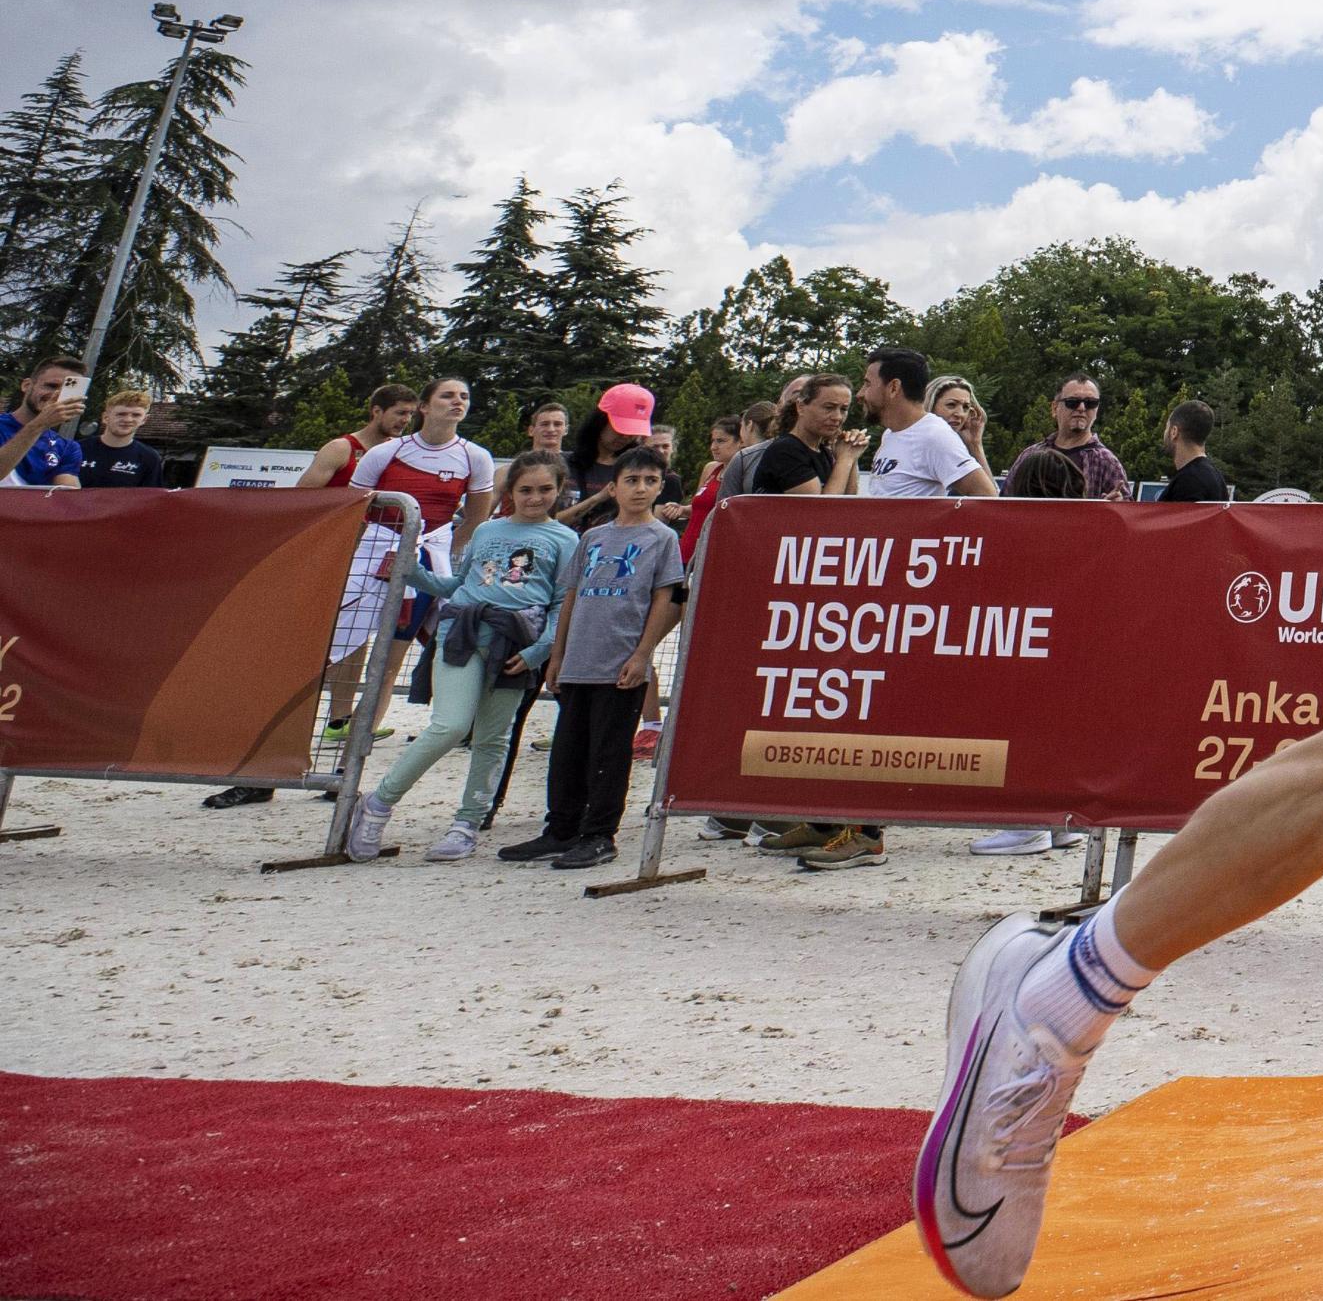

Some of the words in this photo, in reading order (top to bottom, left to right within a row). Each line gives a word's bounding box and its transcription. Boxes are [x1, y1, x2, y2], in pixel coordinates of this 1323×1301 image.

[773, 535, 895, 587] NEW
[905, 535, 983, 589] 5TH
[761, 601, 1053, 658] DISCIPLINE
[756, 666, 886, 721] TEST
[764, 745, 863, 767] OBSTACLE
[870, 750, 982, 772] DISCIPLINE
